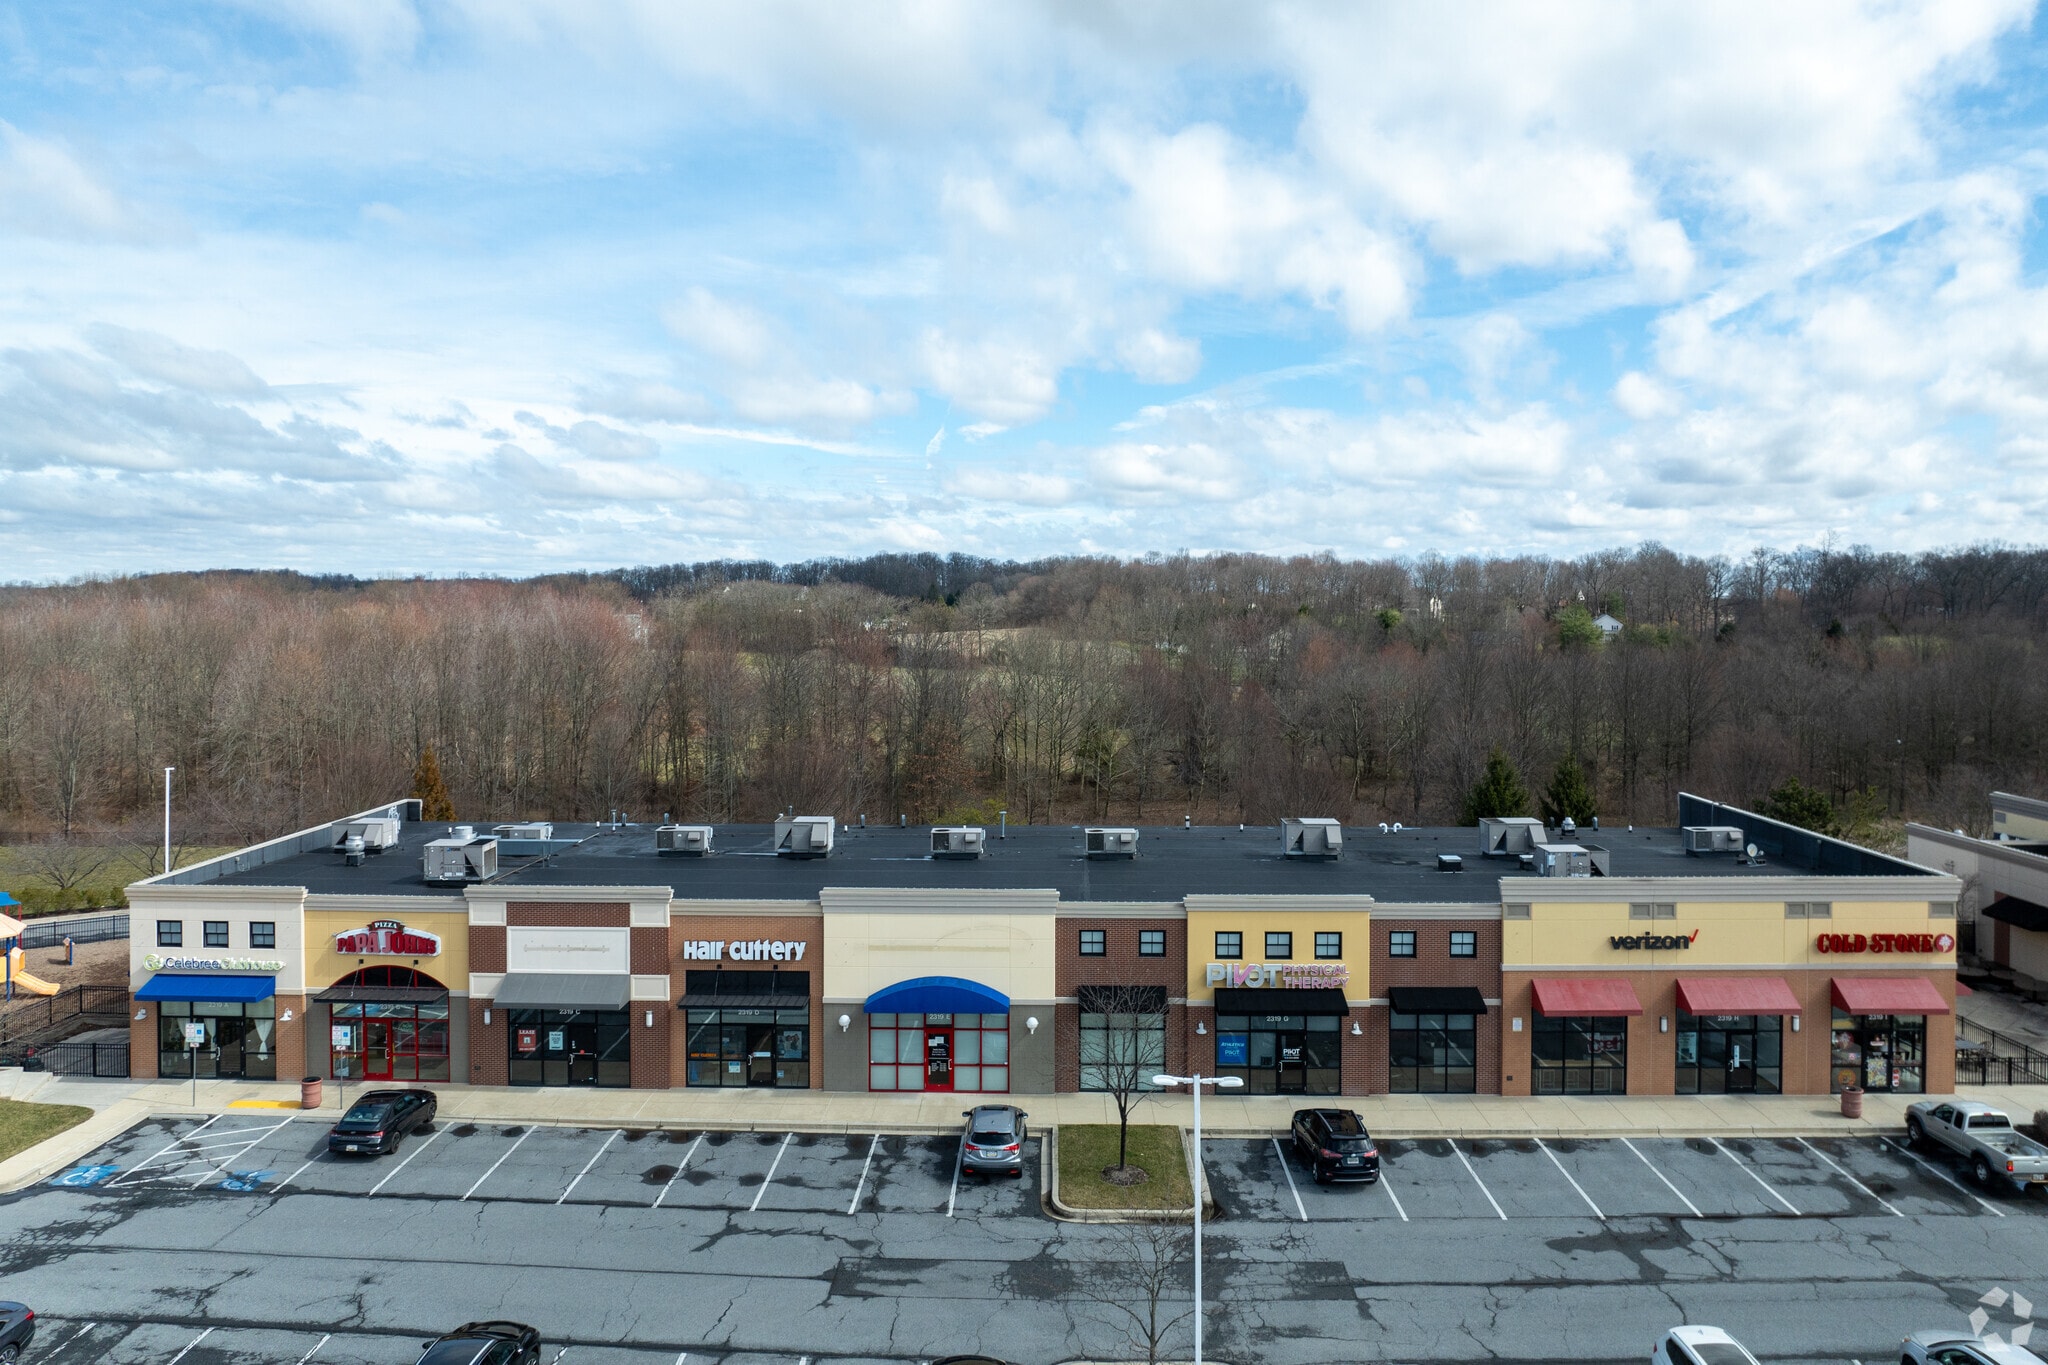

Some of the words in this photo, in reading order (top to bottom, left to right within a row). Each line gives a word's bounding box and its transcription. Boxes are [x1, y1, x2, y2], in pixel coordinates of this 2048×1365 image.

[337, 931, 380, 953] PAPA
[683, 940, 725, 960] Hair
[1610, 931, 1689, 950] verizon
[1816, 933, 1867, 954] COLD
[1869, 933, 1934, 954] STONE
[165, 956, 219, 970] Celebree
[220, 956, 283, 971] Clubhouse
[1282, 964, 1349, 977] PHYSICAL
[1206, 963, 1282, 989] PIVOT
[1283, 976, 1350, 990] THERAPY
